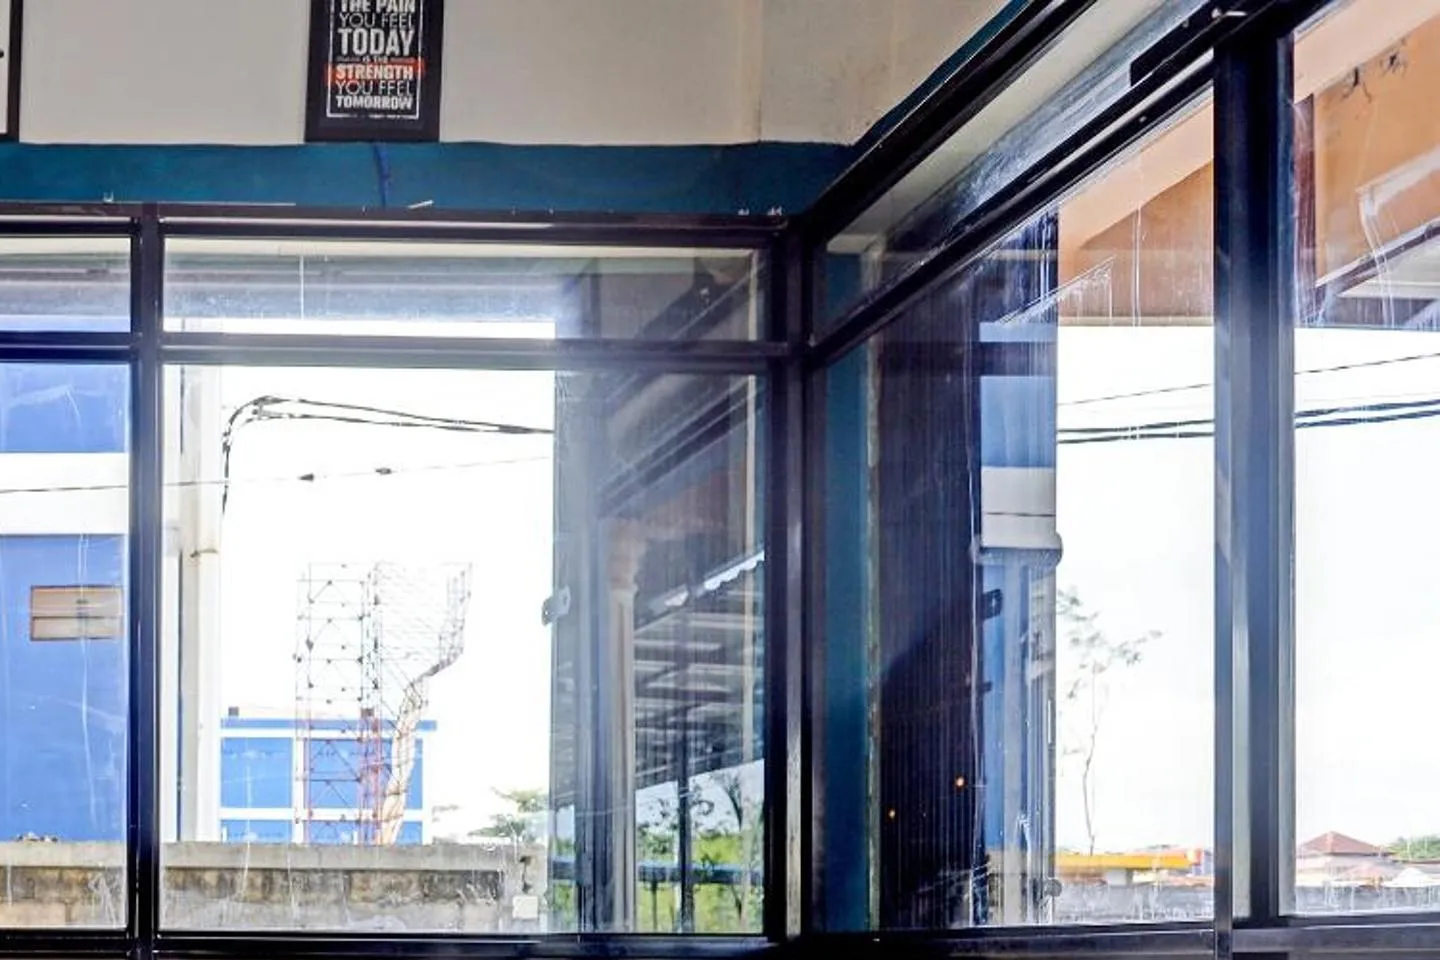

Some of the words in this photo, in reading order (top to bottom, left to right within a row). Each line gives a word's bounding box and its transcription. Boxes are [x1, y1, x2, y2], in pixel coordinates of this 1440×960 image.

[340, 0, 371, 13] THE
[375, 0, 416, 13] PAIN
[339, 13, 375, 28] YOU
[381, 13, 414, 29] FEEL
[338, 28, 415, 56] TODAY
[336, 64, 414, 80] STRENGTH
[335, 80, 373, 96] YOU
[379, 80, 412, 96] FEEL
[335, 95, 414, 110] TOMORROW
